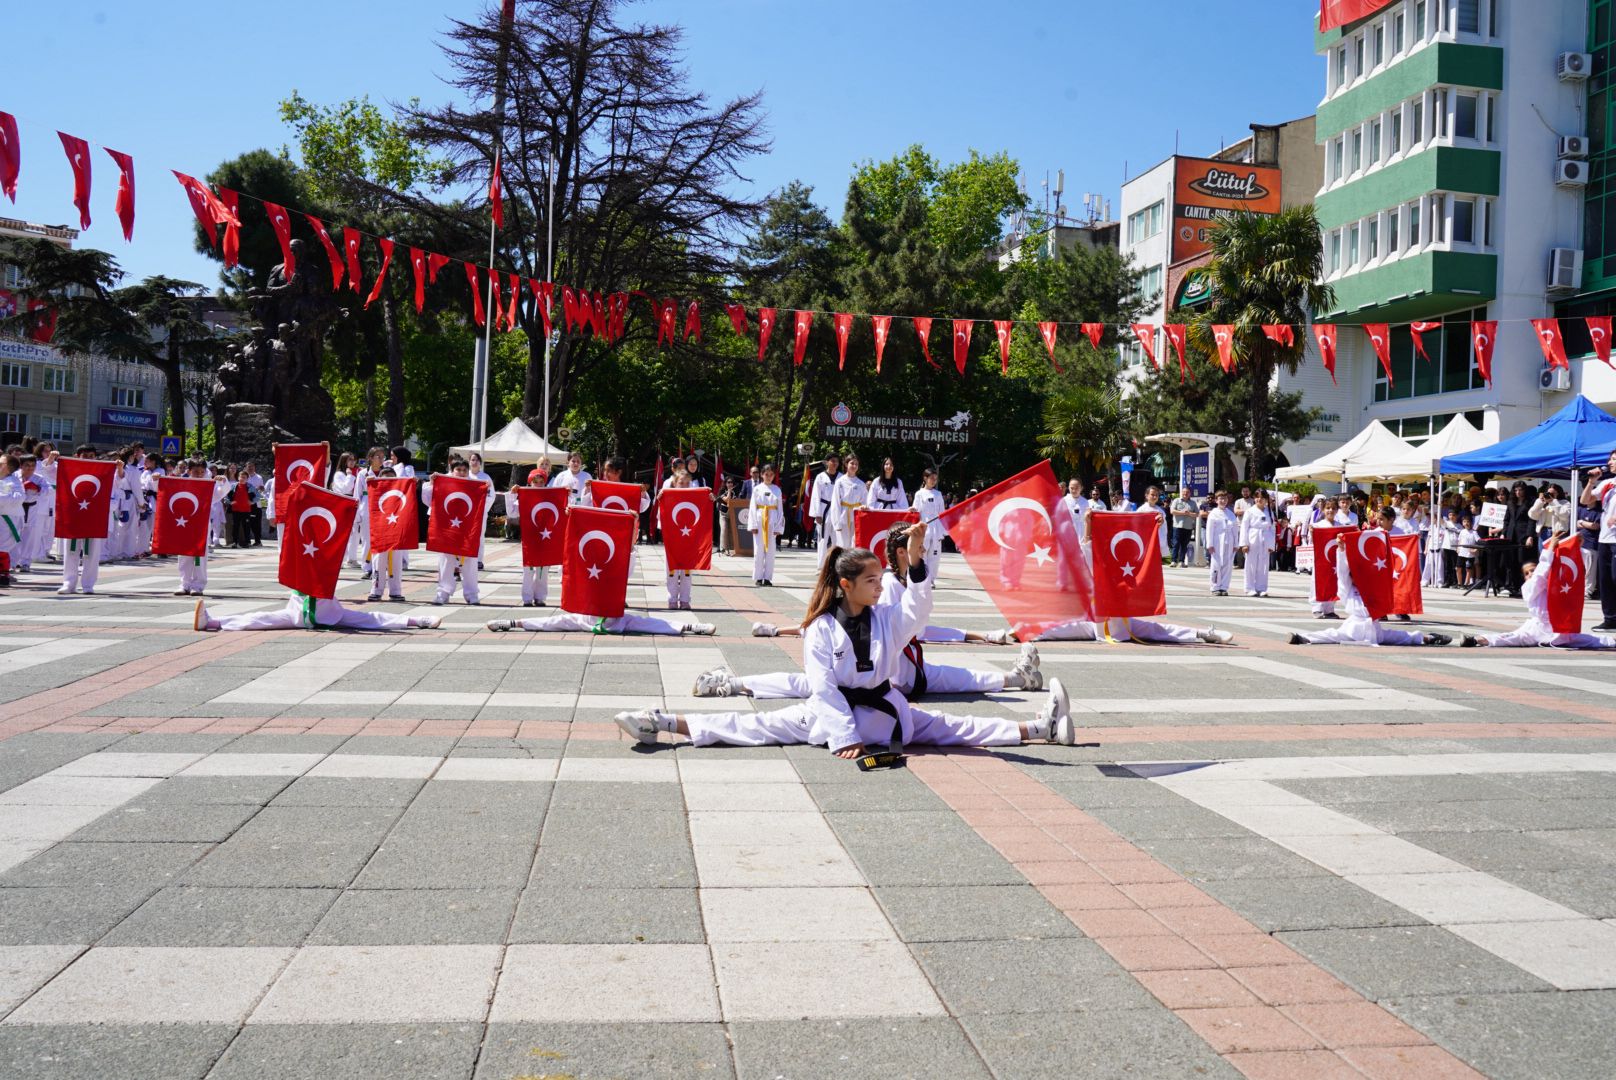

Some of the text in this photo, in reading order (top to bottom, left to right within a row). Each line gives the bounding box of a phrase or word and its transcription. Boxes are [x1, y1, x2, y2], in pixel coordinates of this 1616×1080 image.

[1203, 169, 1256, 196] Lütuf
[0, 341, 50, 357] athPro
[134, 416, 151, 425] GRUP
[857, 415, 940, 429] ORHANGAZİ BELEDİYESİ
[826, 425, 969, 445] MEYDAN AİLE ÇAY BAHÇESİ
